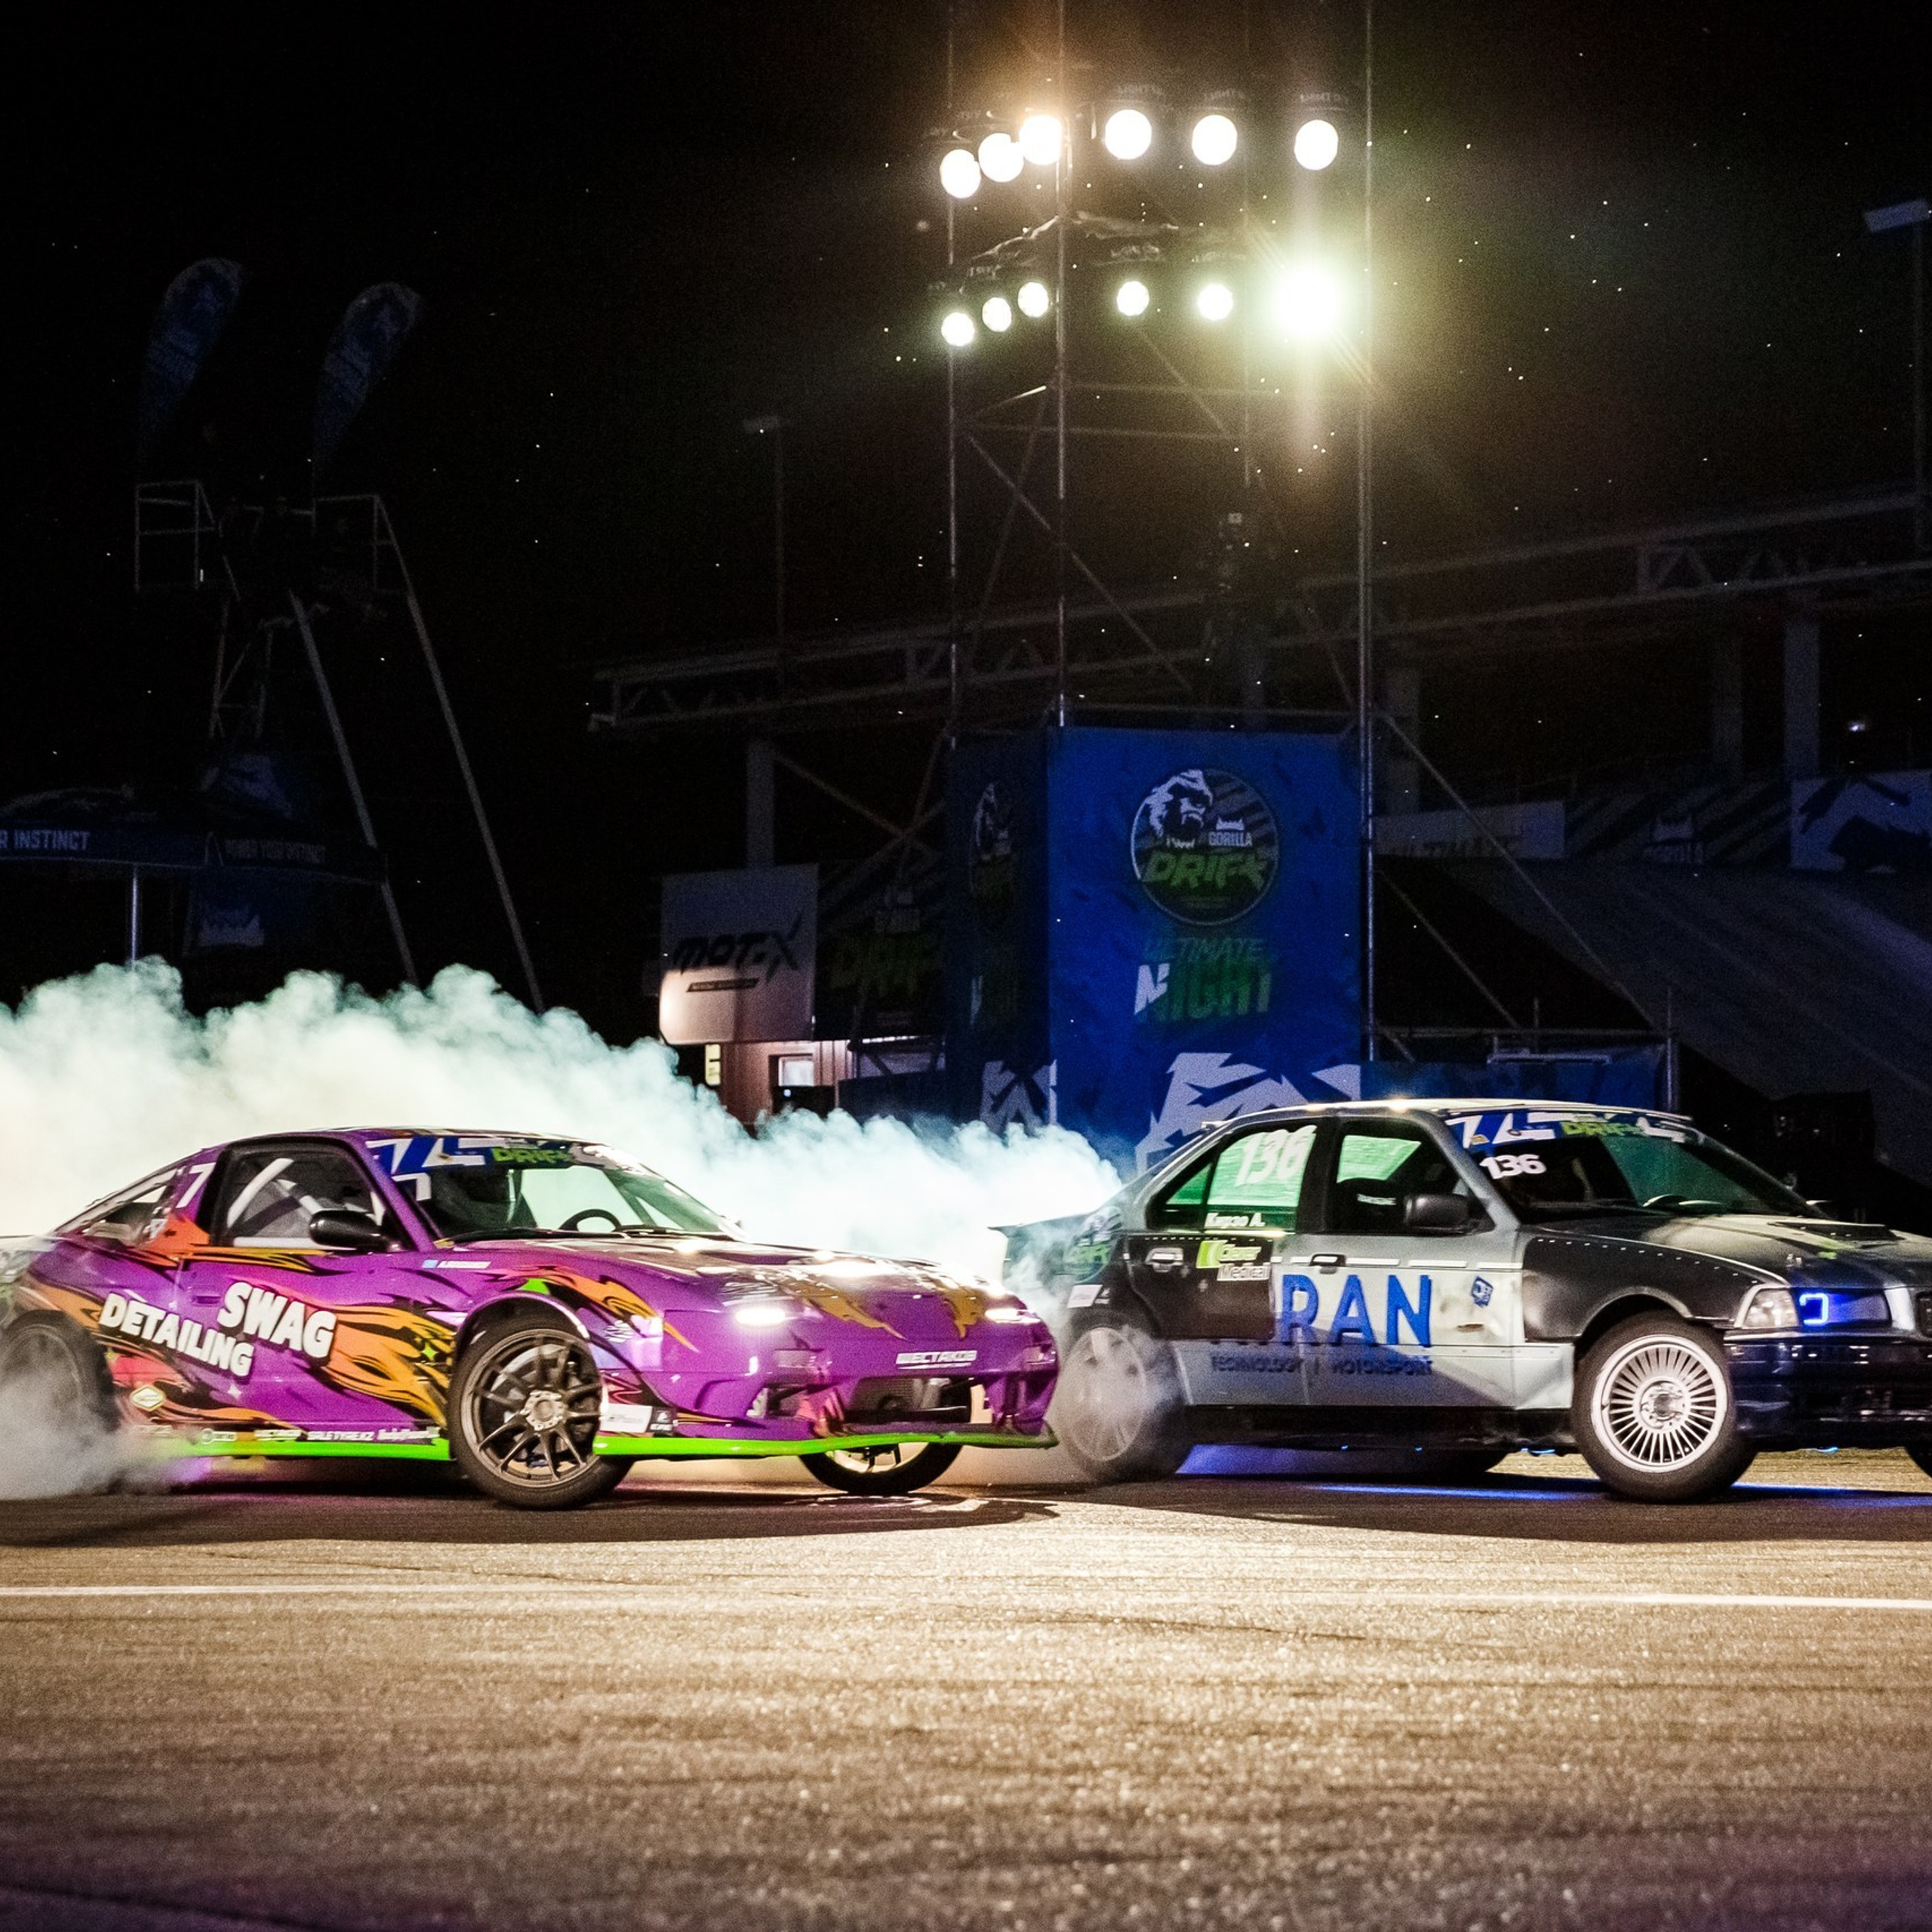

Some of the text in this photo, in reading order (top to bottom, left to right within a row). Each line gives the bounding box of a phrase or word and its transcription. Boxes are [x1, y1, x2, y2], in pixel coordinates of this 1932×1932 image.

[14, 830, 91, 851] INSTINCT
[1209, 831, 1254, 847] GORILLA
[1235, 1126, 1318, 1186] 136
[1479, 1153, 1546, 1179] 136
[174, 1162, 216, 1208] 7
[1217, 1263, 1271, 1281] Medical
[99, 1292, 254, 1377] DETAILING
[218, 1281, 337, 1359] SWAG
